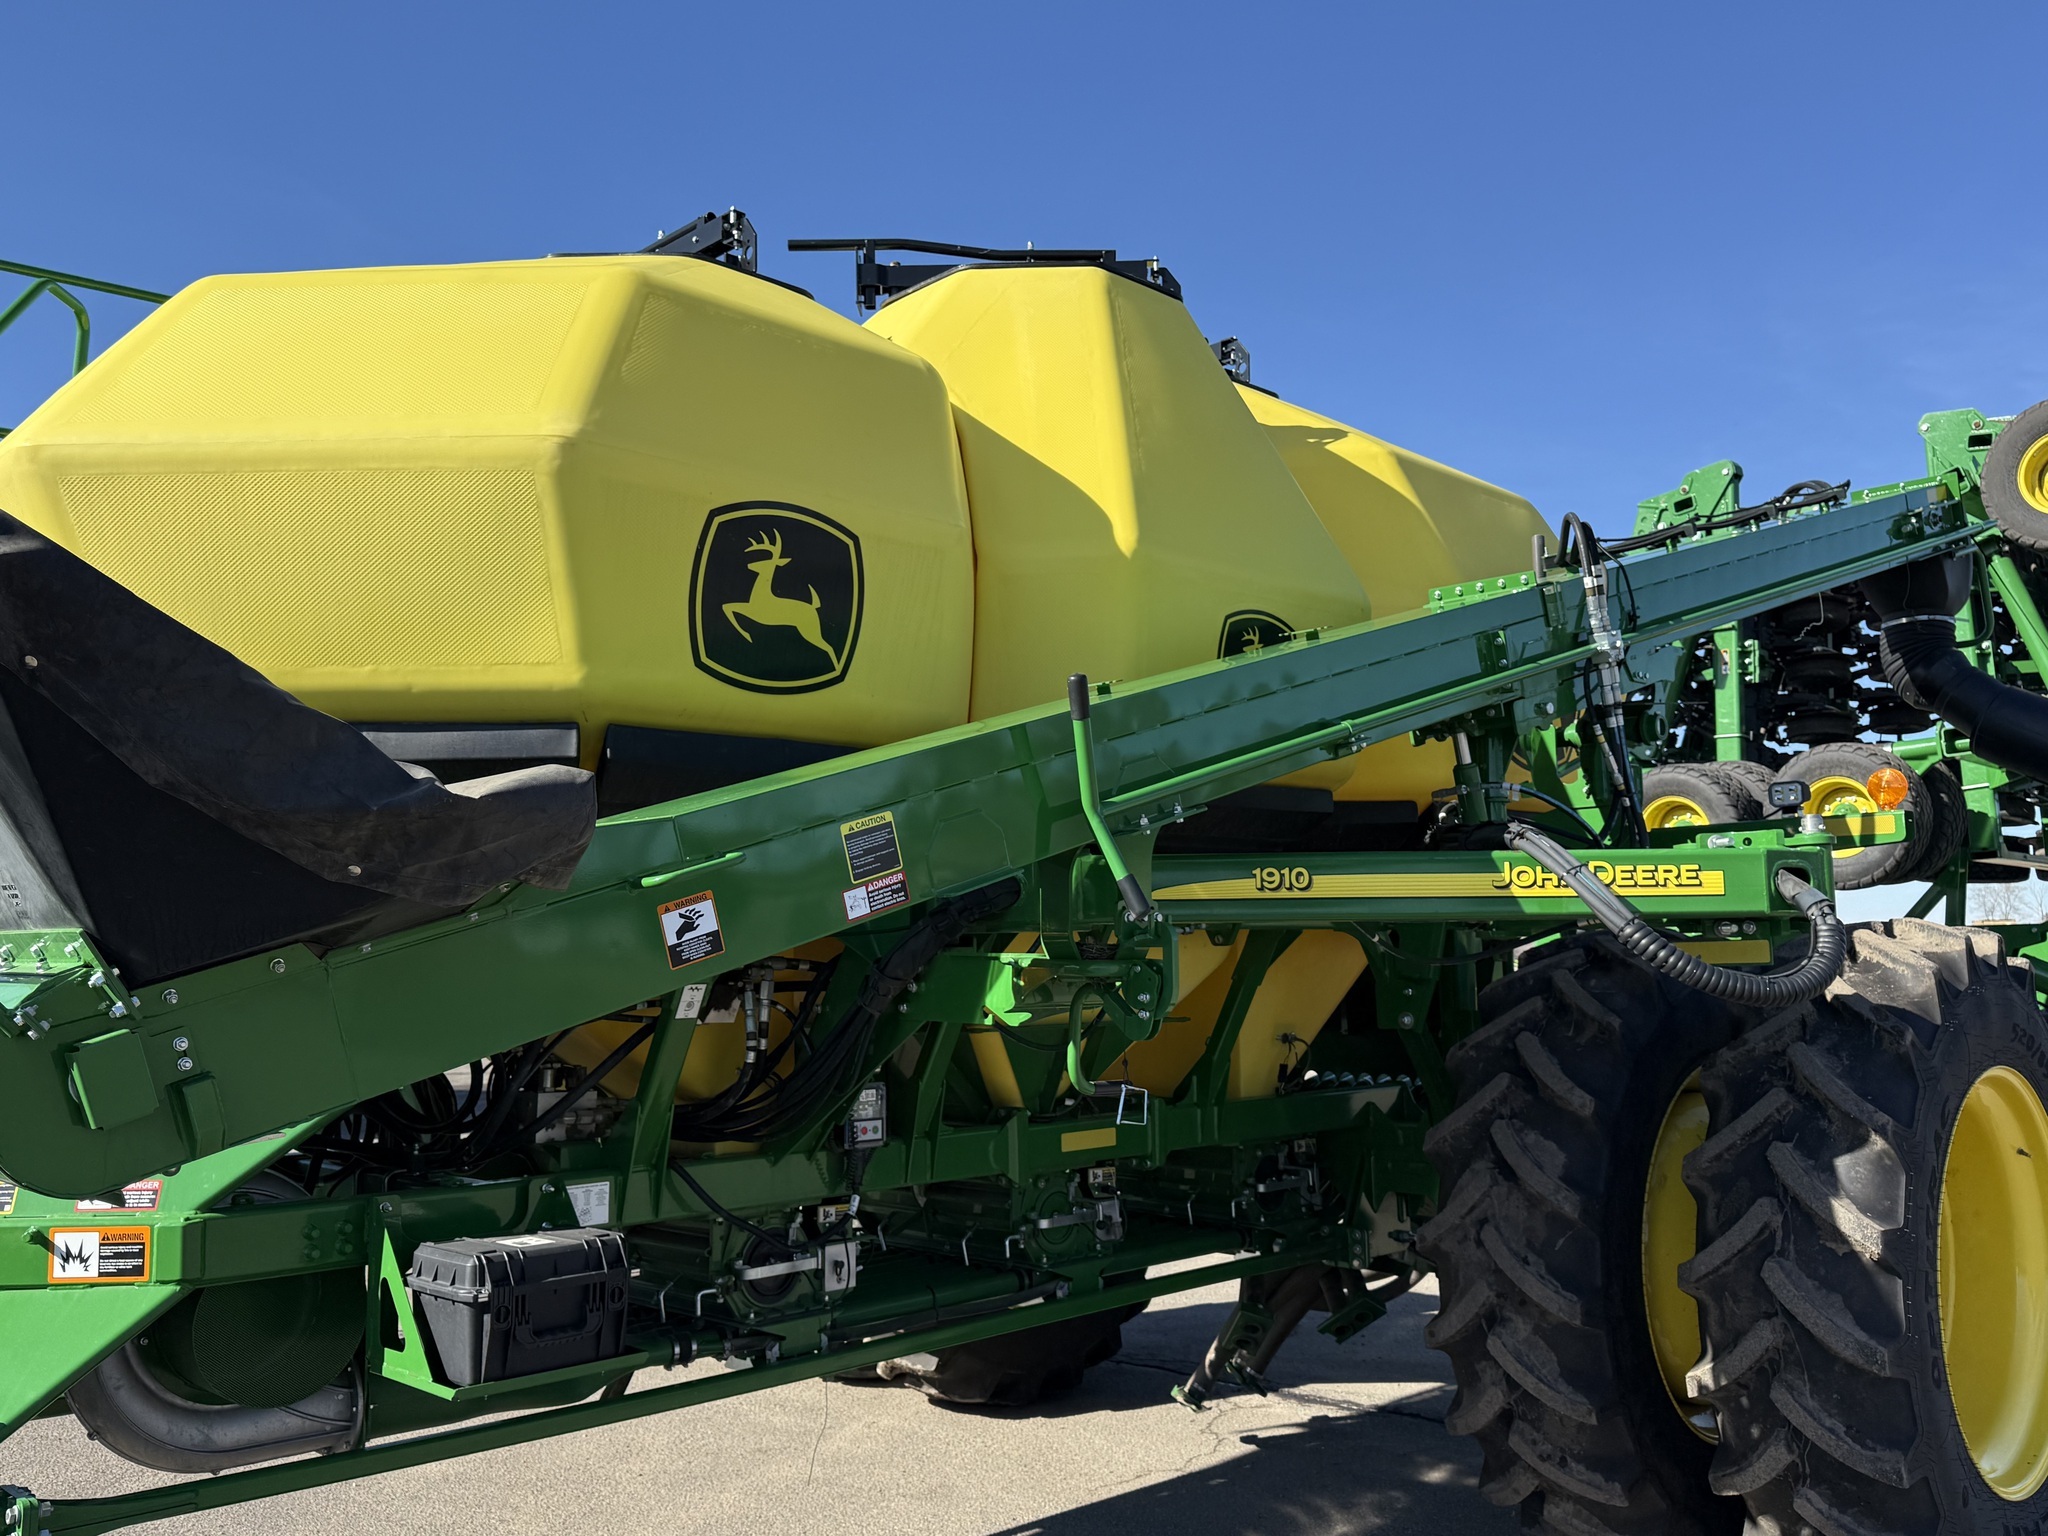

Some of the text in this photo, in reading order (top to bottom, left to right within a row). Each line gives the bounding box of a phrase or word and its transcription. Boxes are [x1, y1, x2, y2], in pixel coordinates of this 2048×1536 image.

[855, 815, 886, 829] CAUTION
[873, 873, 903, 889] DANGER
[1251, 866, 1312, 891] 1910
[1492, 860, 1704, 888] JOH DEERE
[673, 893, 708, 910] WARNING
[130, 1181, 160, 1190] ANGER
[110, 1233, 144, 1241] WARNING
